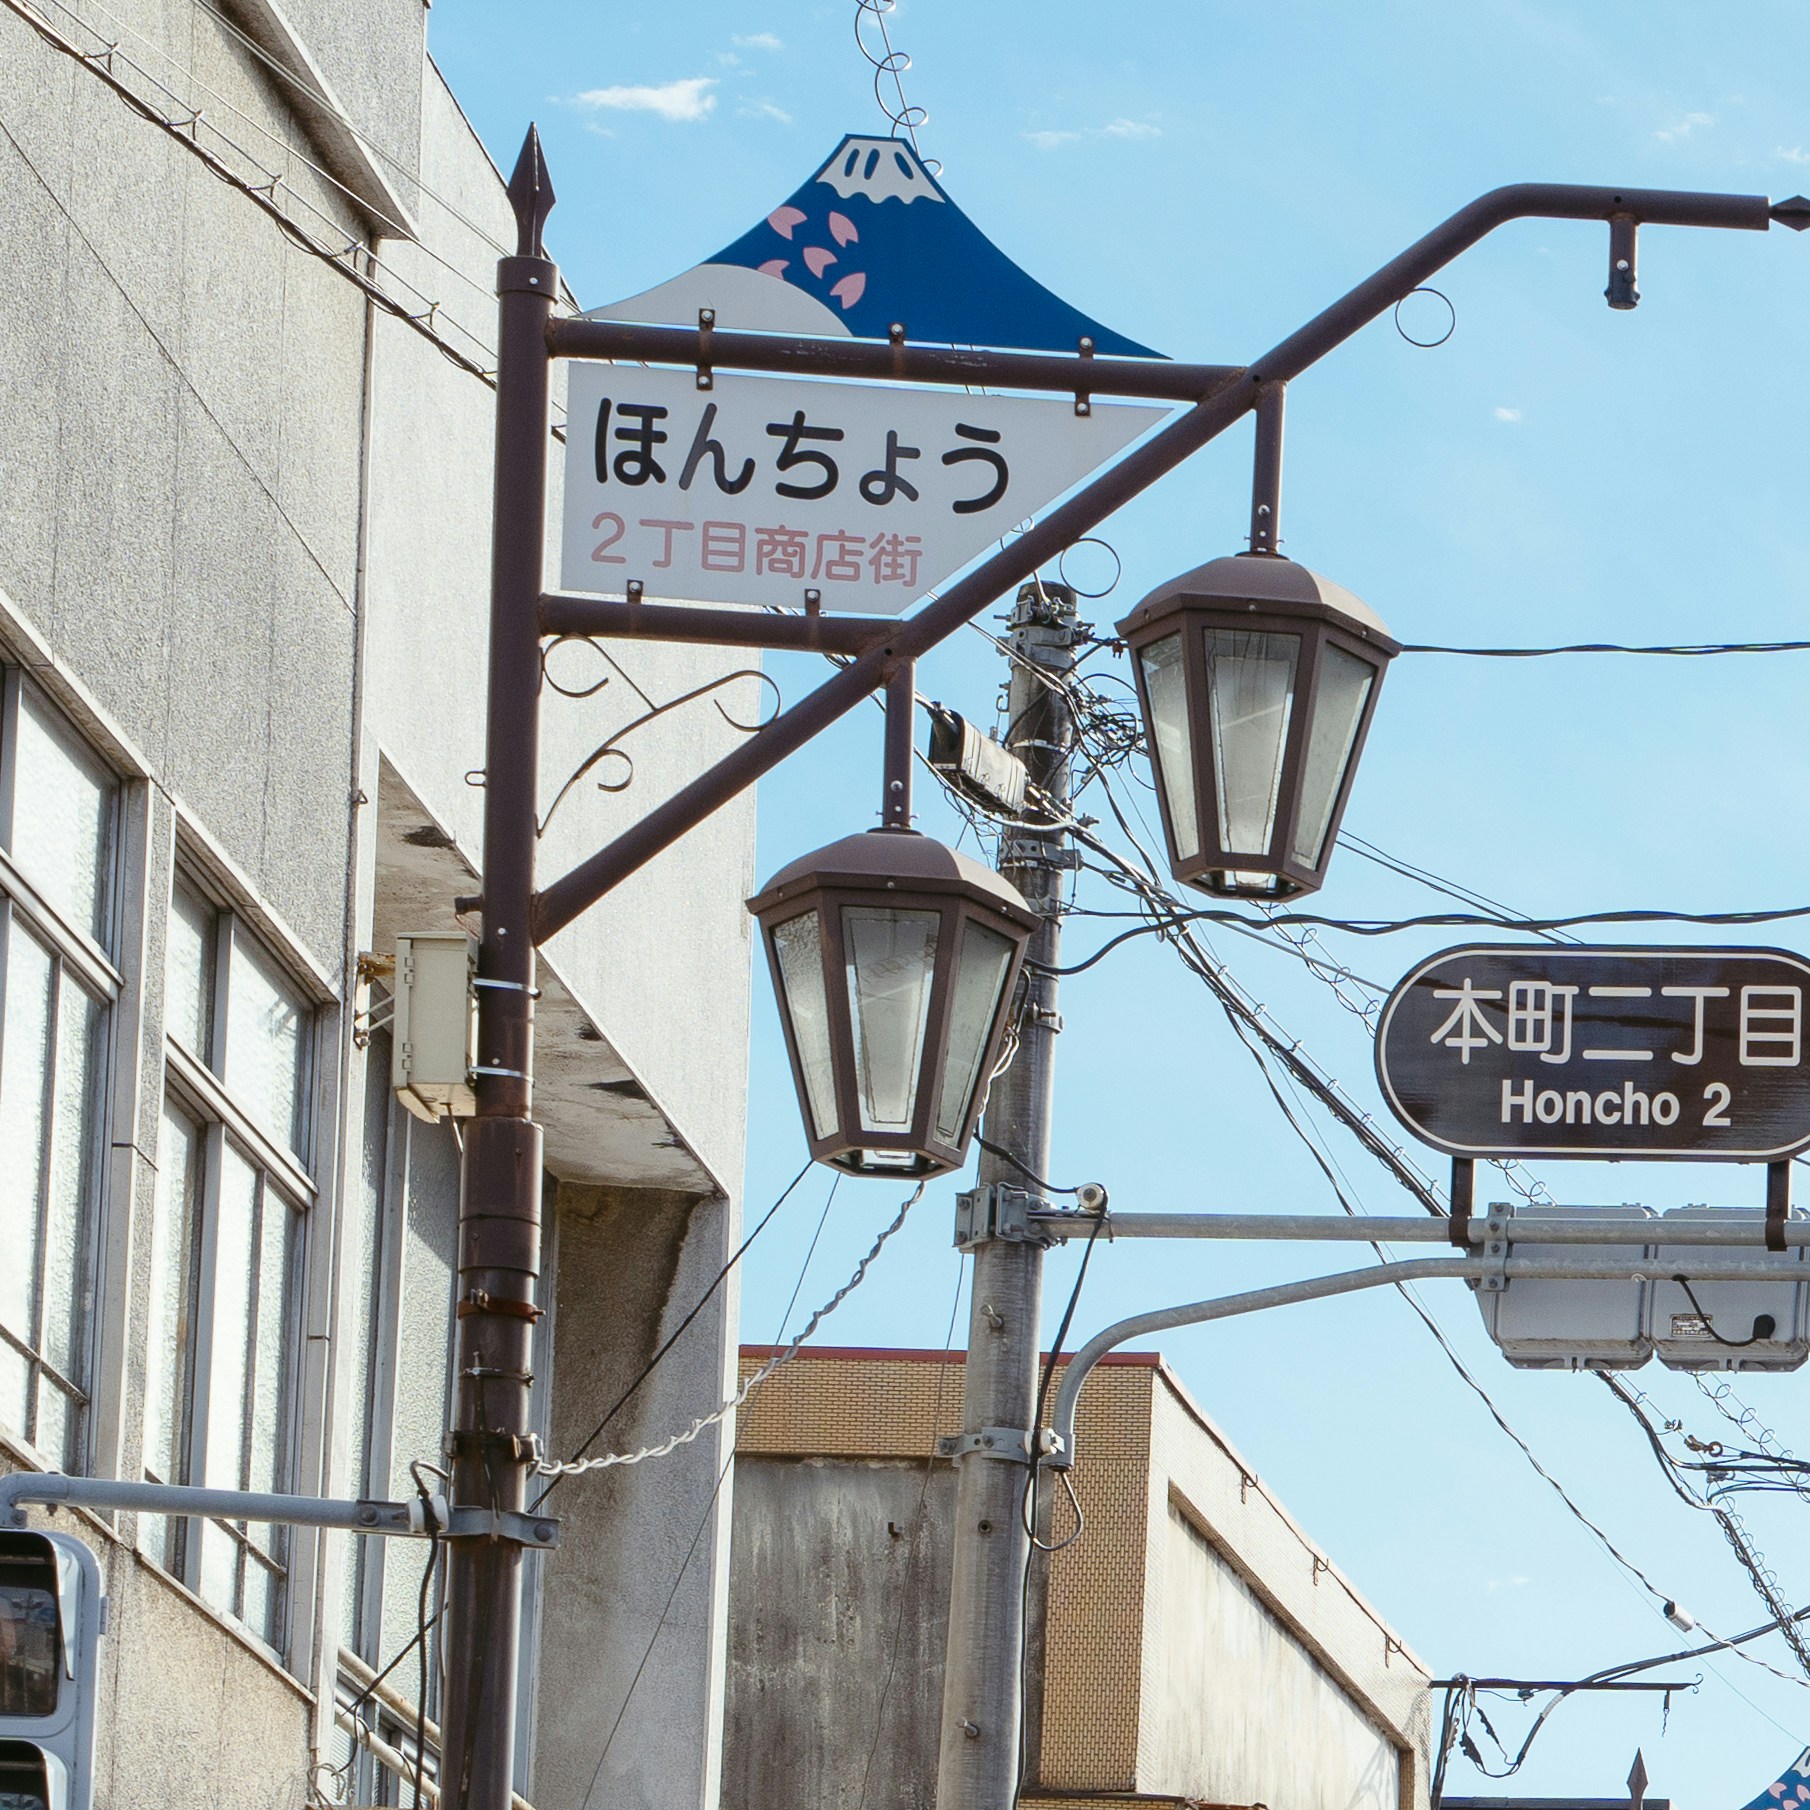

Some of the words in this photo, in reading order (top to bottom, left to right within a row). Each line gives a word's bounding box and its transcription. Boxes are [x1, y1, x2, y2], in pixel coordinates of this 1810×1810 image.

[593, 396, 1010, 515] ほんちょう
[591, 512, 923, 588] 2丁目商店街
[1430, 977, 1803, 1067] 本町二丁目
[1501, 1079, 1680, 1127] Honcho
[1702, 1082, 1732, 1127] 2
